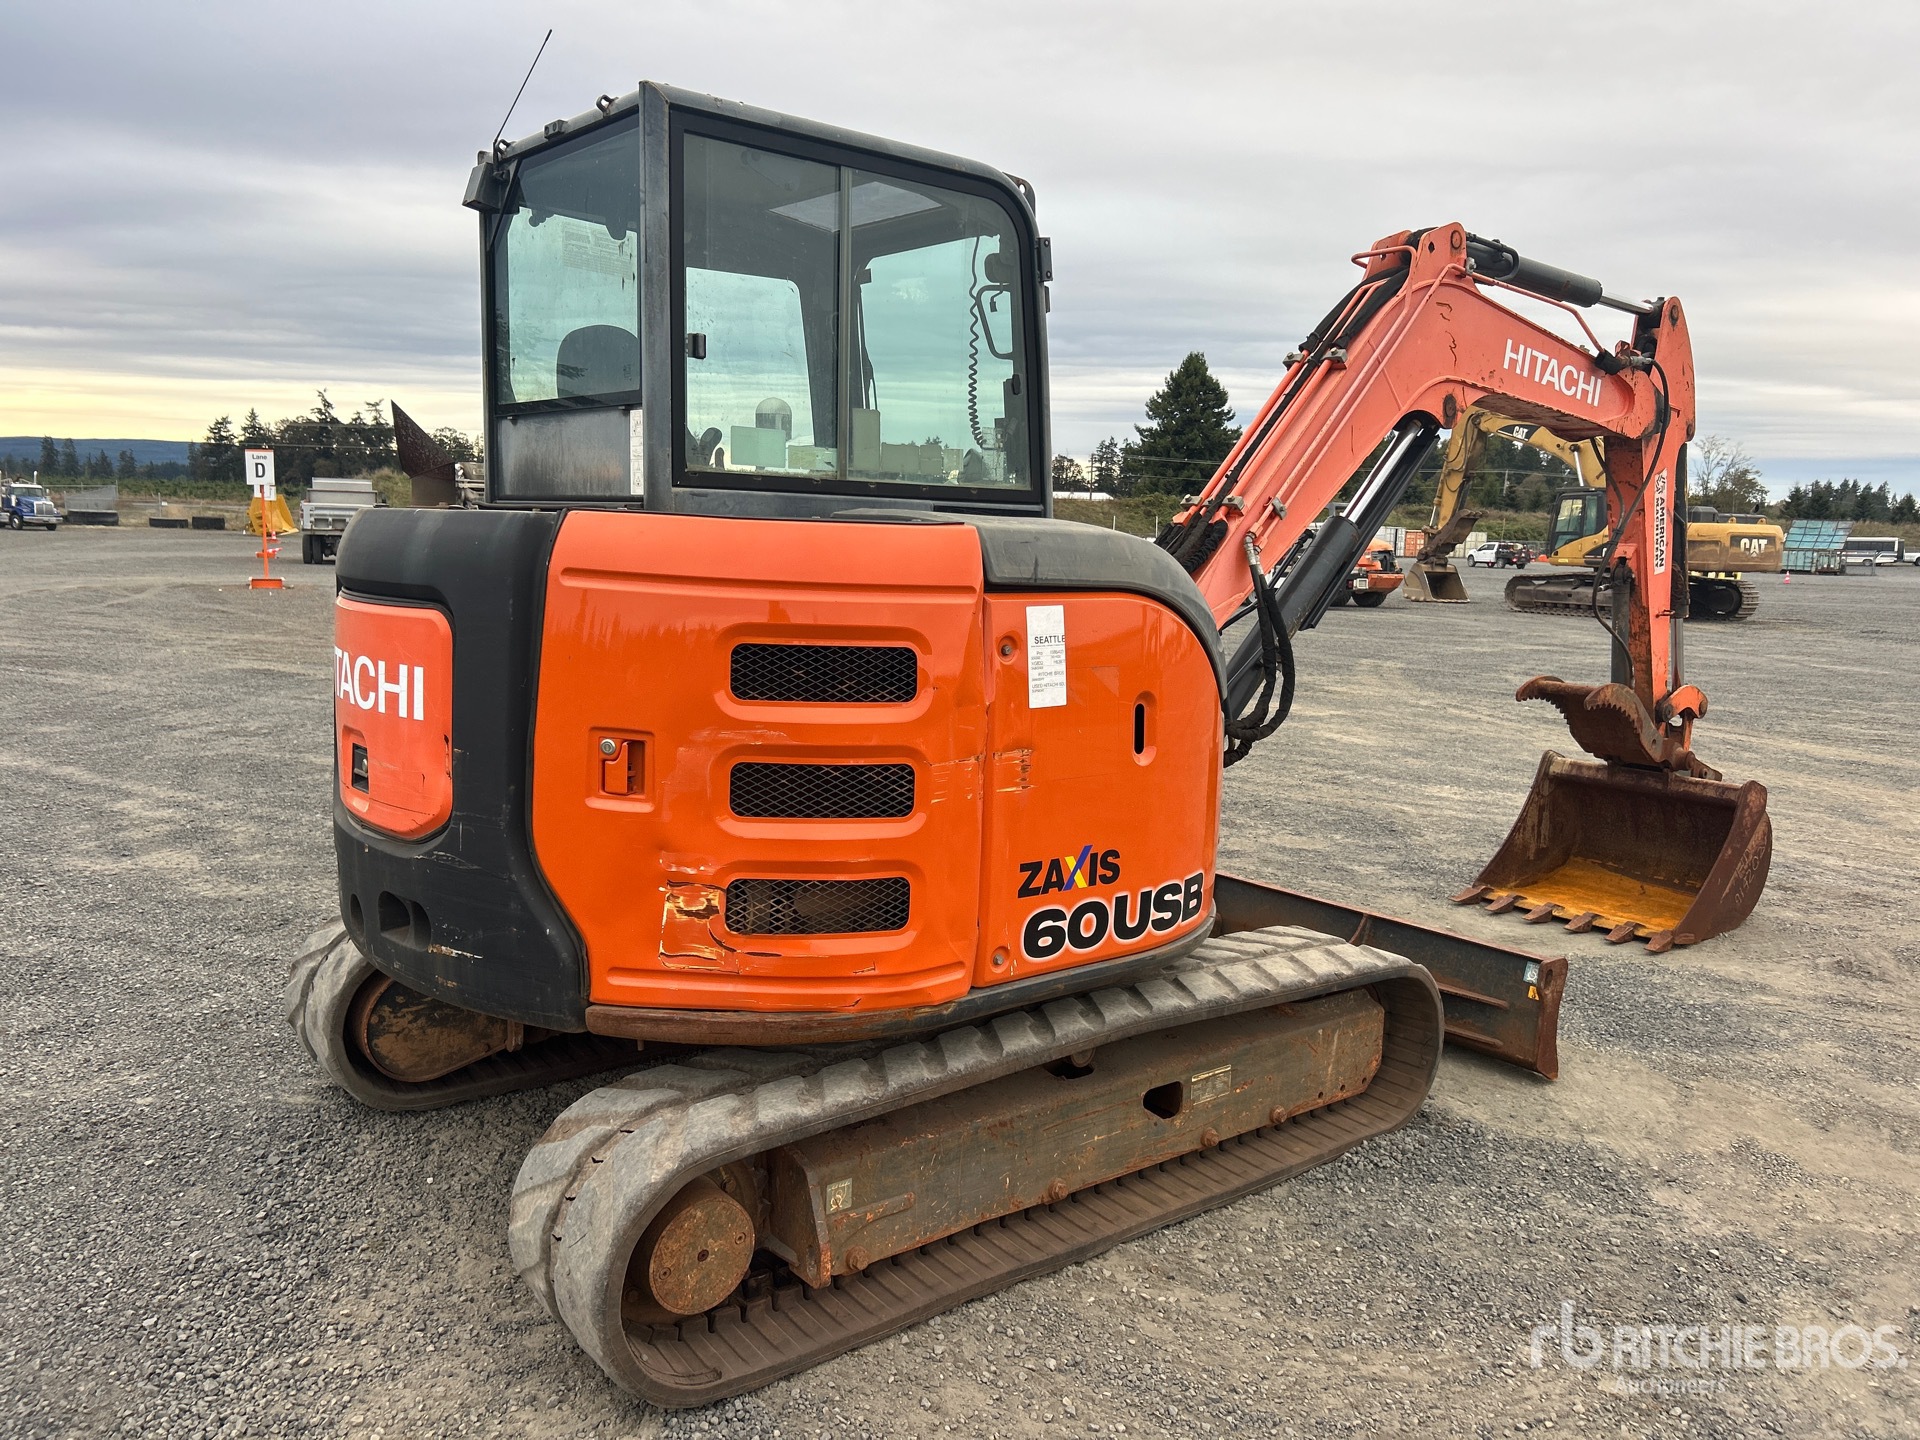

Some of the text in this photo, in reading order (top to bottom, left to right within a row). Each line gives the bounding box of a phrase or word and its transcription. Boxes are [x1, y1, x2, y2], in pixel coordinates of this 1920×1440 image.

[1503, 338, 1602, 407] HITACHI
[1512, 426, 1528, 439] CAT
[254, 462, 266, 478] D
[1740, 538, 1768, 557] CAT
[1034, 635, 1065, 644] SEATTLE
[334, 646, 424, 721] TACHI
[1017, 845, 1121, 899] ZAXIS
[1023, 872, 1204, 959] 60USB
